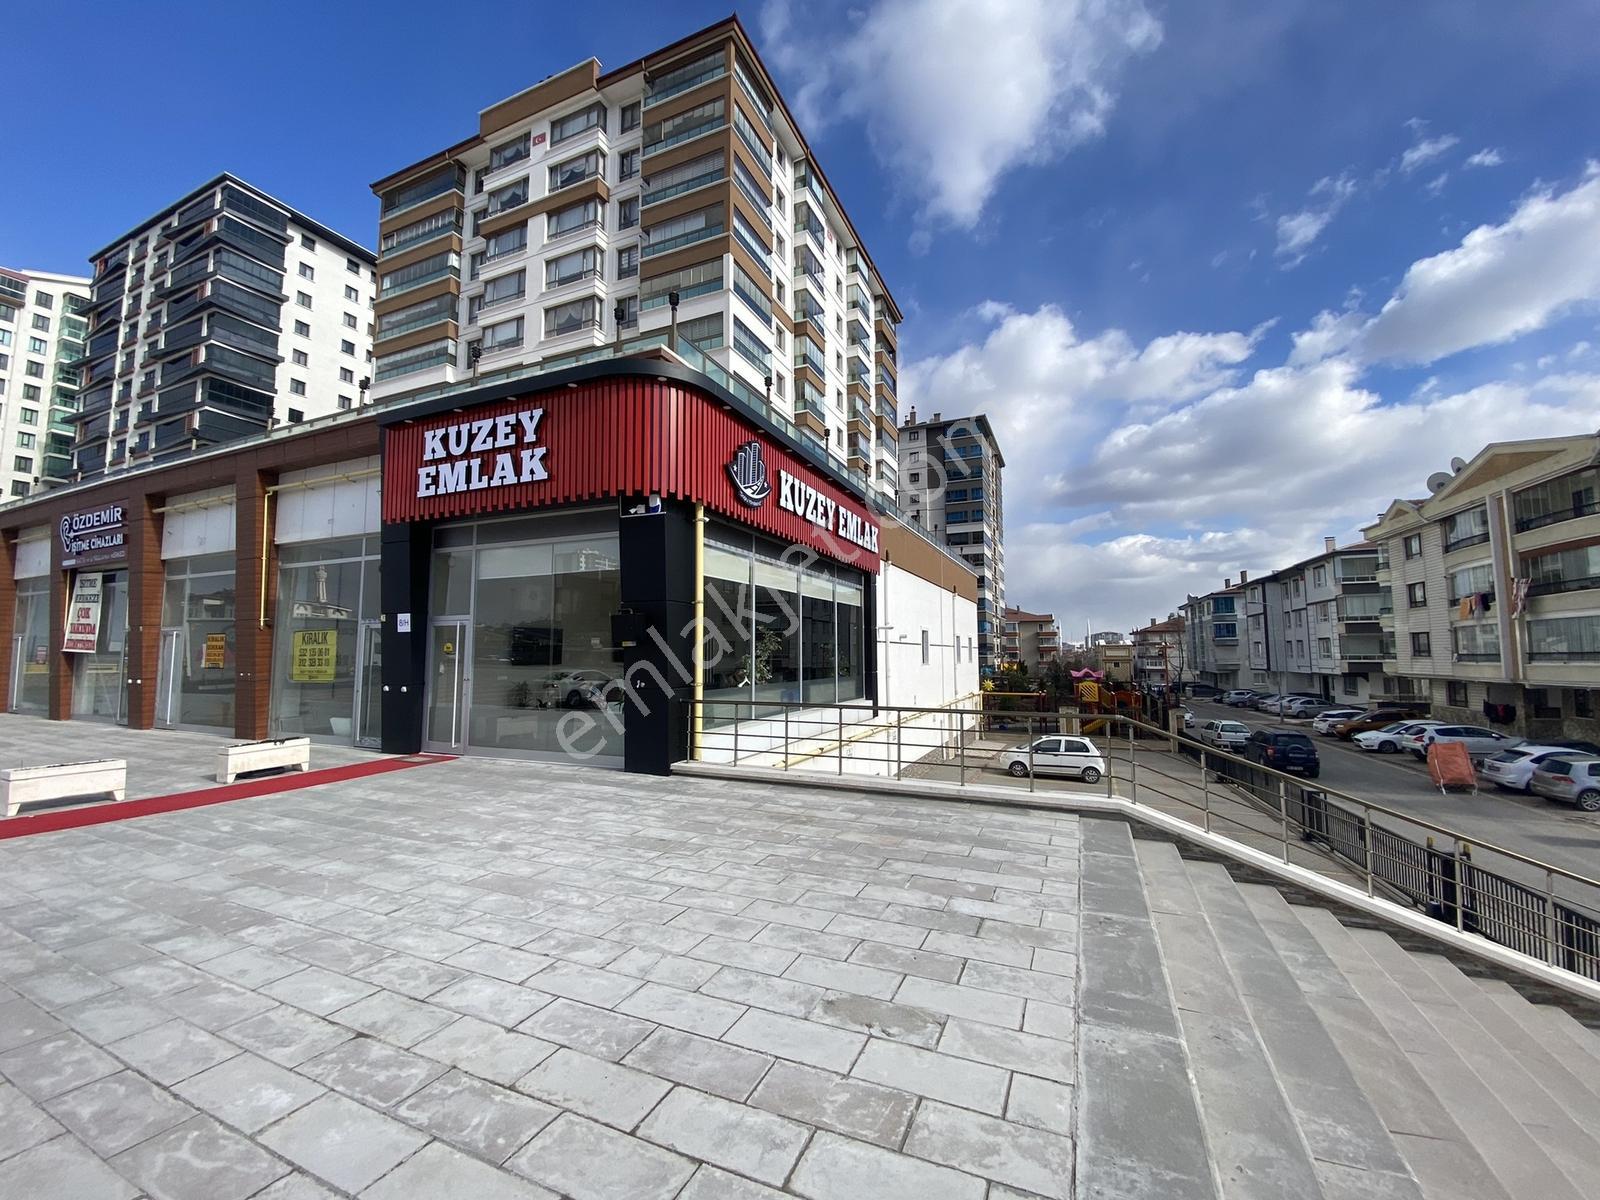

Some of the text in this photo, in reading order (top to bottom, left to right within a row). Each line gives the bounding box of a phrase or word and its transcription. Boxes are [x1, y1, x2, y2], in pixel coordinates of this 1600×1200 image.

[423, 408, 544, 461] KUZEY
[417, 447, 548, 498] EMLAK
[72, 505, 122, 530] ÖZDEMİR
[779, 469, 879, 554] KUZEY EMLAK
[90, 533, 123, 549] CİHAZLARI
